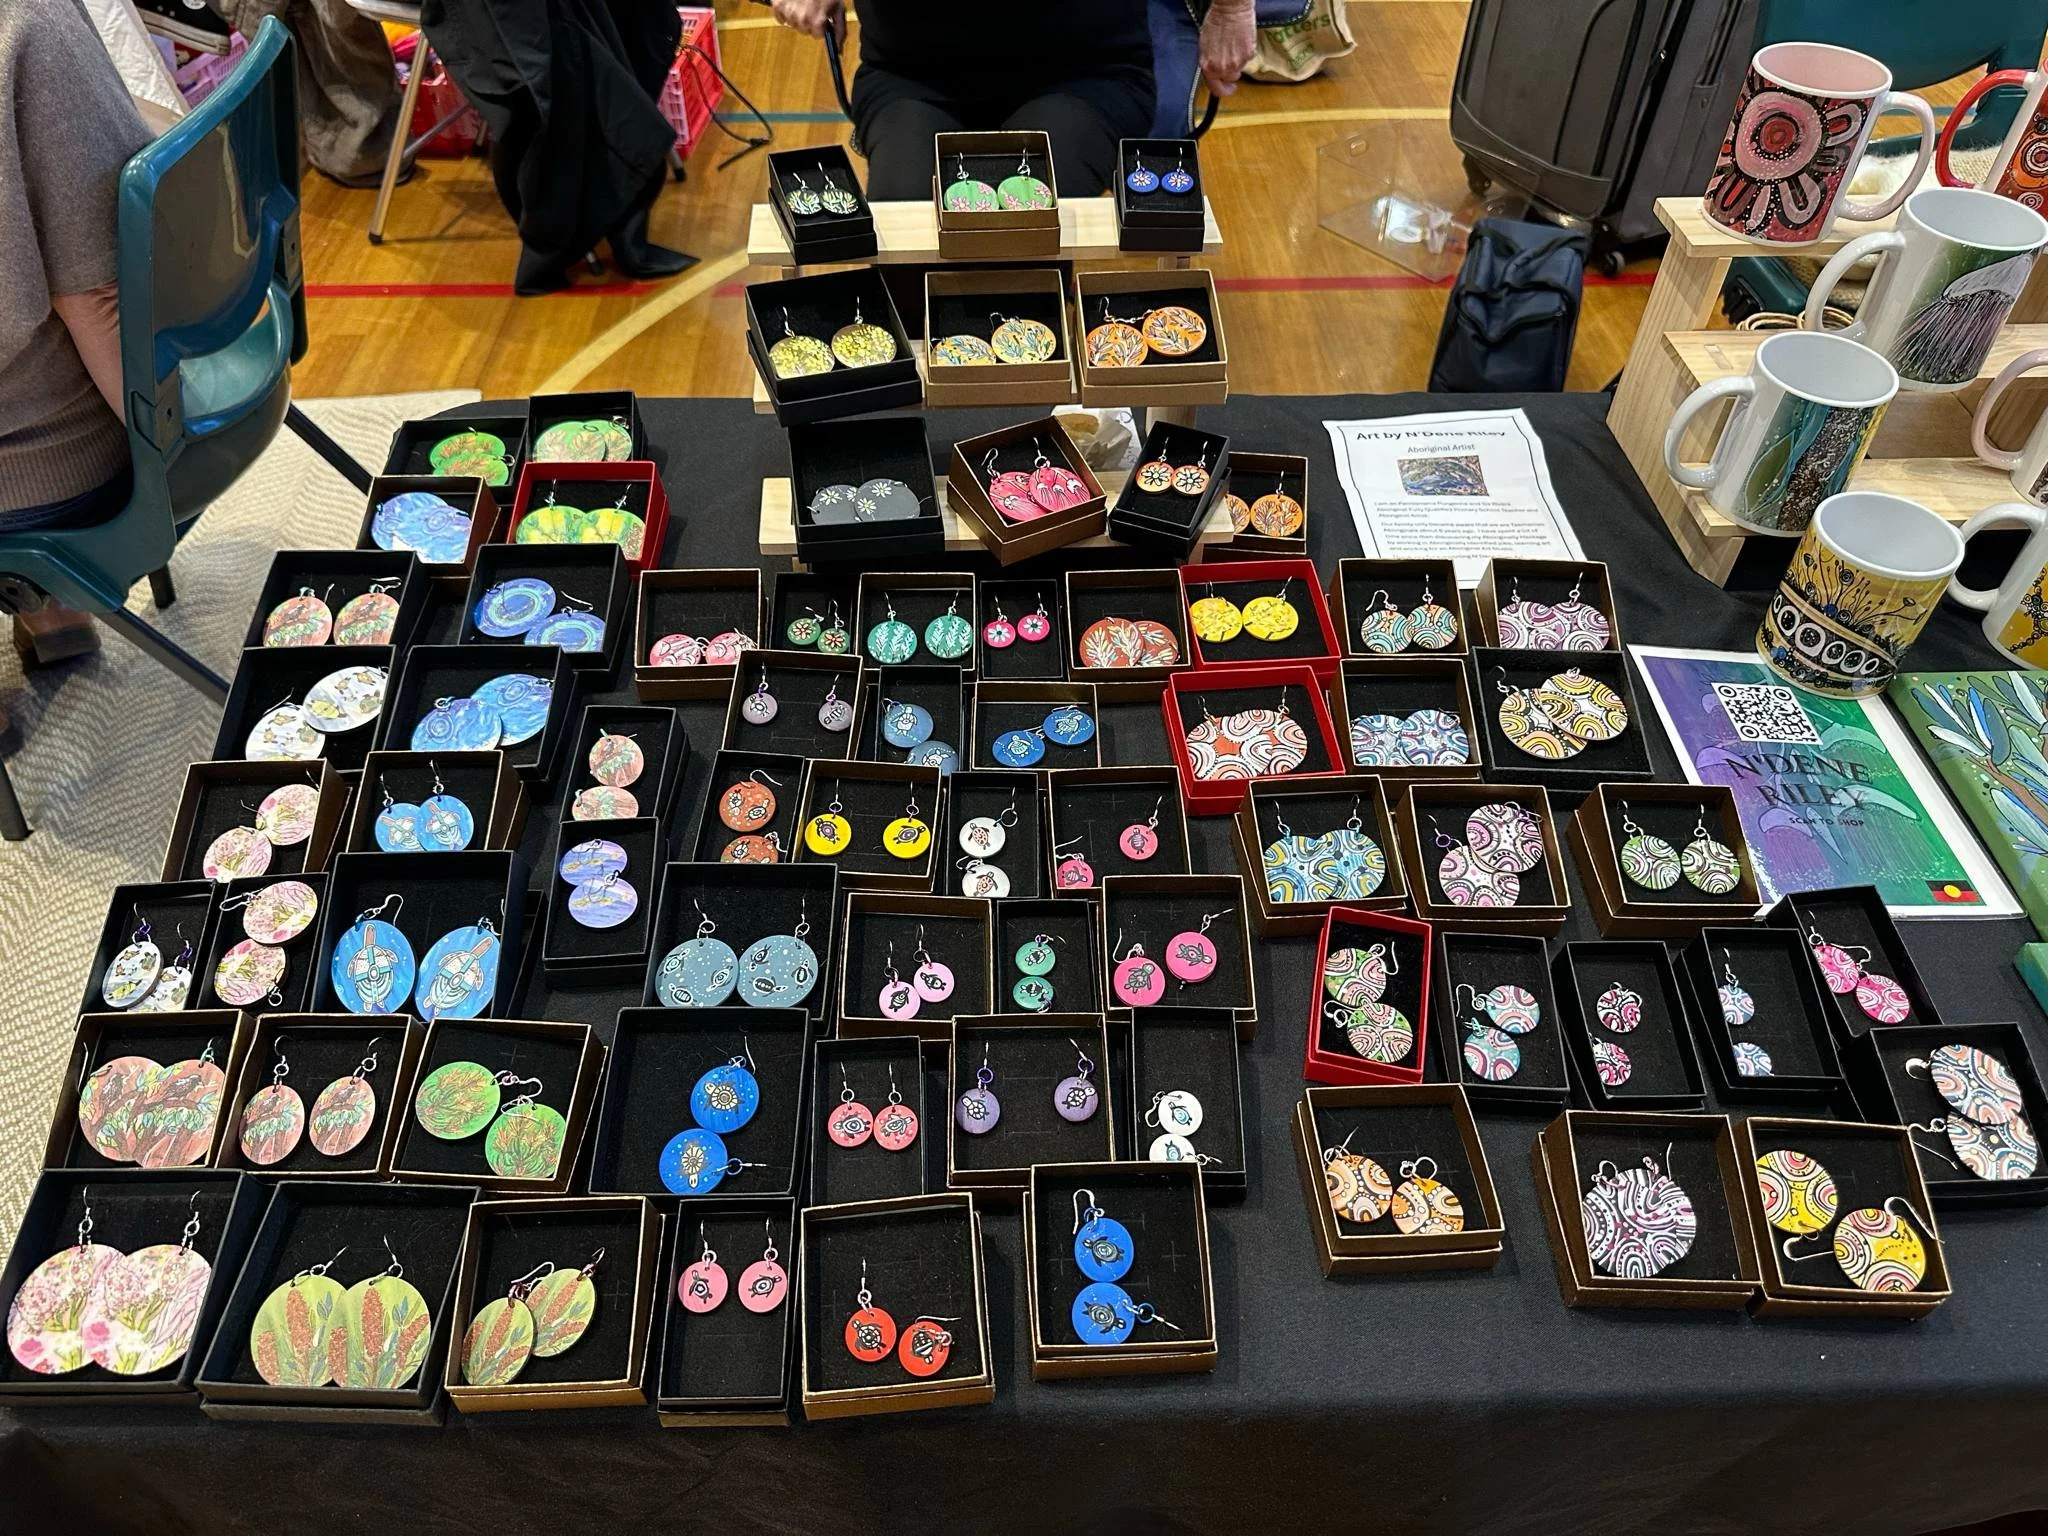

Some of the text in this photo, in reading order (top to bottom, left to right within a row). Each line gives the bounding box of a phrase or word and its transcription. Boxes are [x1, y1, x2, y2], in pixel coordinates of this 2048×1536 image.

[1356, 432, 1380, 441] Art
[1383, 431, 1401, 440] by
[1407, 443, 1476, 454] Aboriginal Artist
[1724, 753, 1873, 785] N'DENE
[1754, 783, 1865, 810] RILEY
[1789, 817, 1865, 827] SCAN TO SHOP
